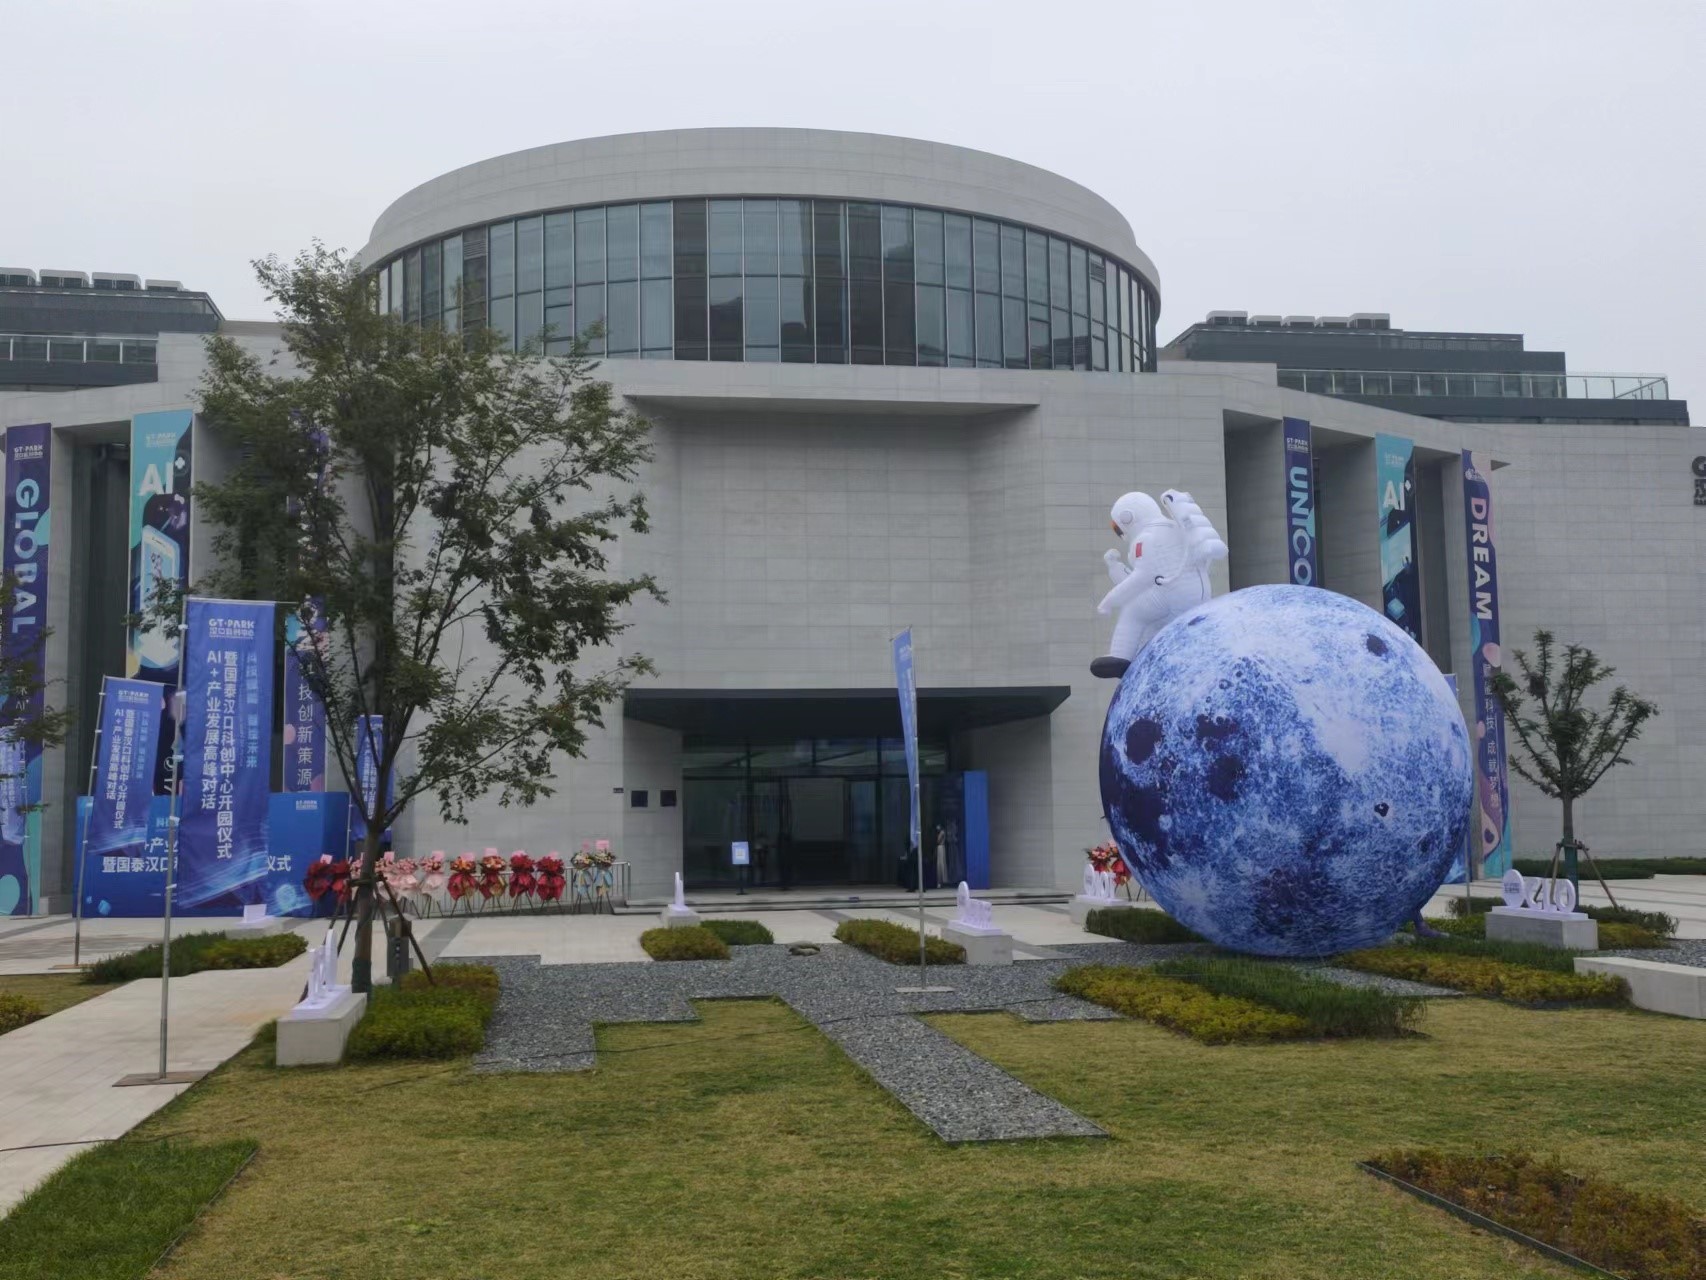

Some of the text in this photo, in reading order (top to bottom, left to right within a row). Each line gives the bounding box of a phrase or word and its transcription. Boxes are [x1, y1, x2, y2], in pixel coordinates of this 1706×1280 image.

[12, 478, 40, 633] GLOBAL
[1470, 497, 1493, 620] DREAM
[201, 650, 222, 810] AI+产业发展高峰对话
[216, 650, 238, 859] 暨国泰汉口科创中心开园仪式
